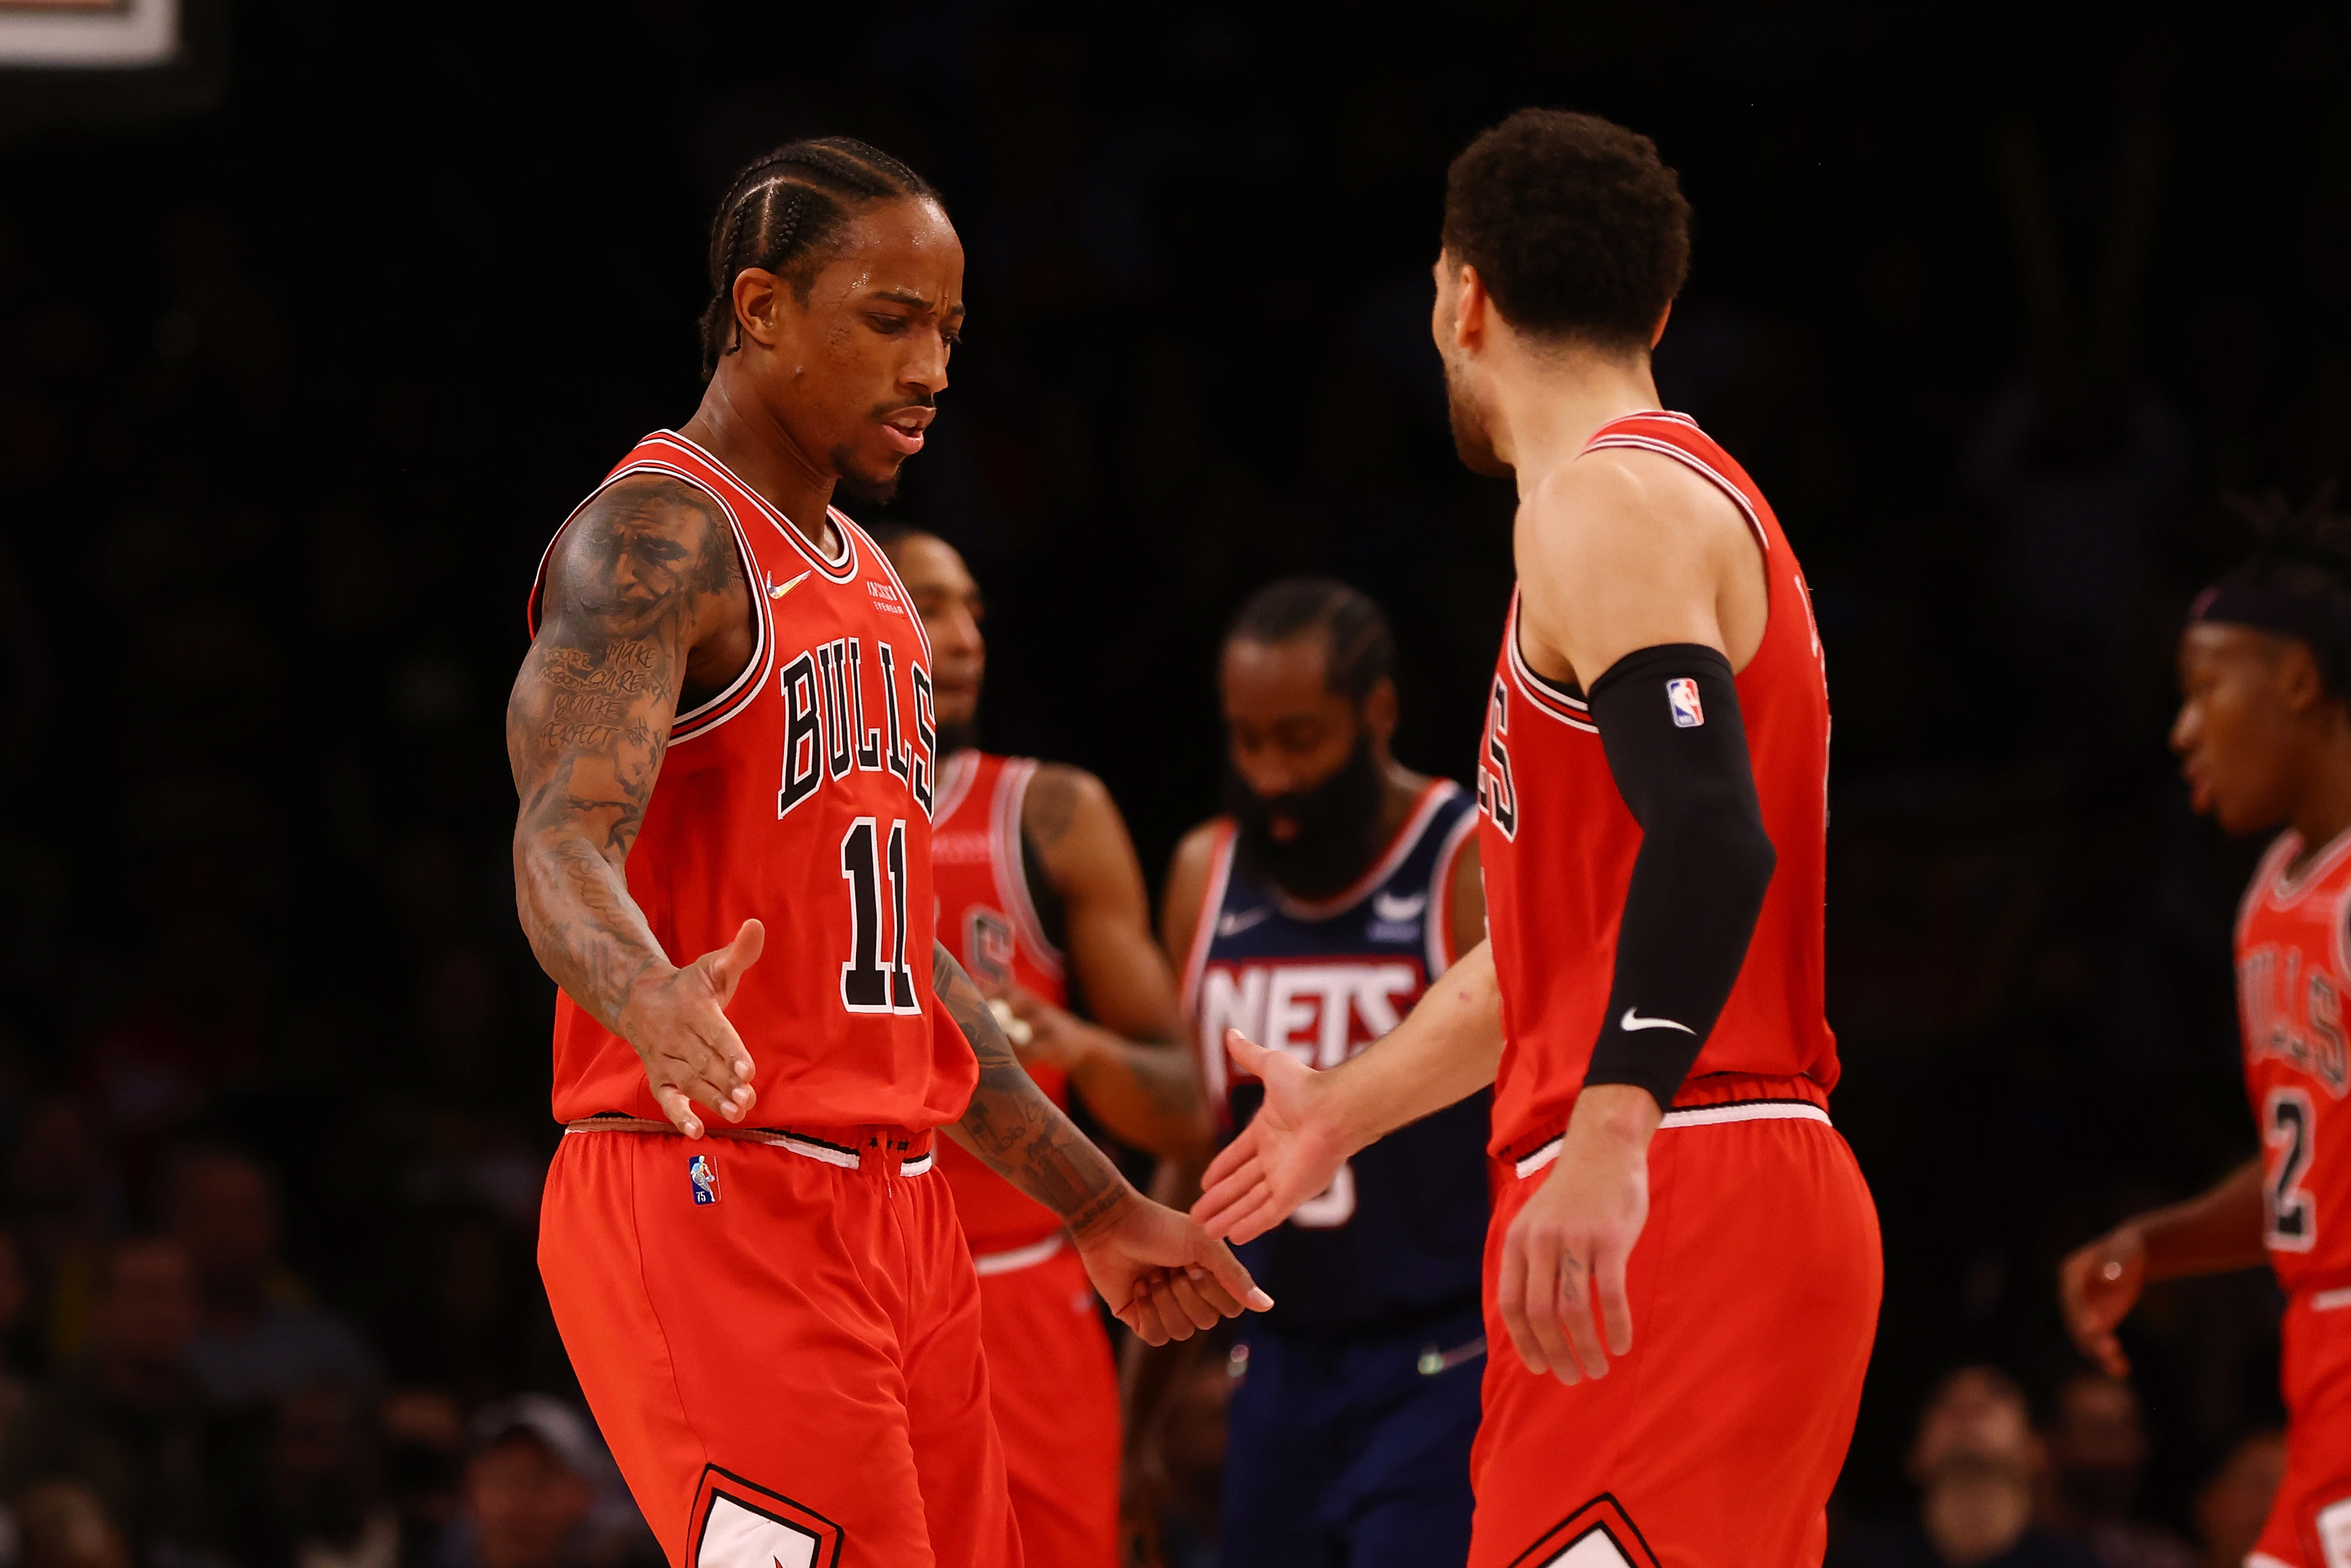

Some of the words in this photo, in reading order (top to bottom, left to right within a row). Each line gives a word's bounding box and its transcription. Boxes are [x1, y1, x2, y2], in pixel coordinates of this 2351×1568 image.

[777, 636, 936, 825] BULLS
[840, 816, 922, 1016] 11
[1199, 961, 1415, 1087] NETS
[696, 1191, 706, 1202] 75
[2262, 1085, 2317, 1254] 2
